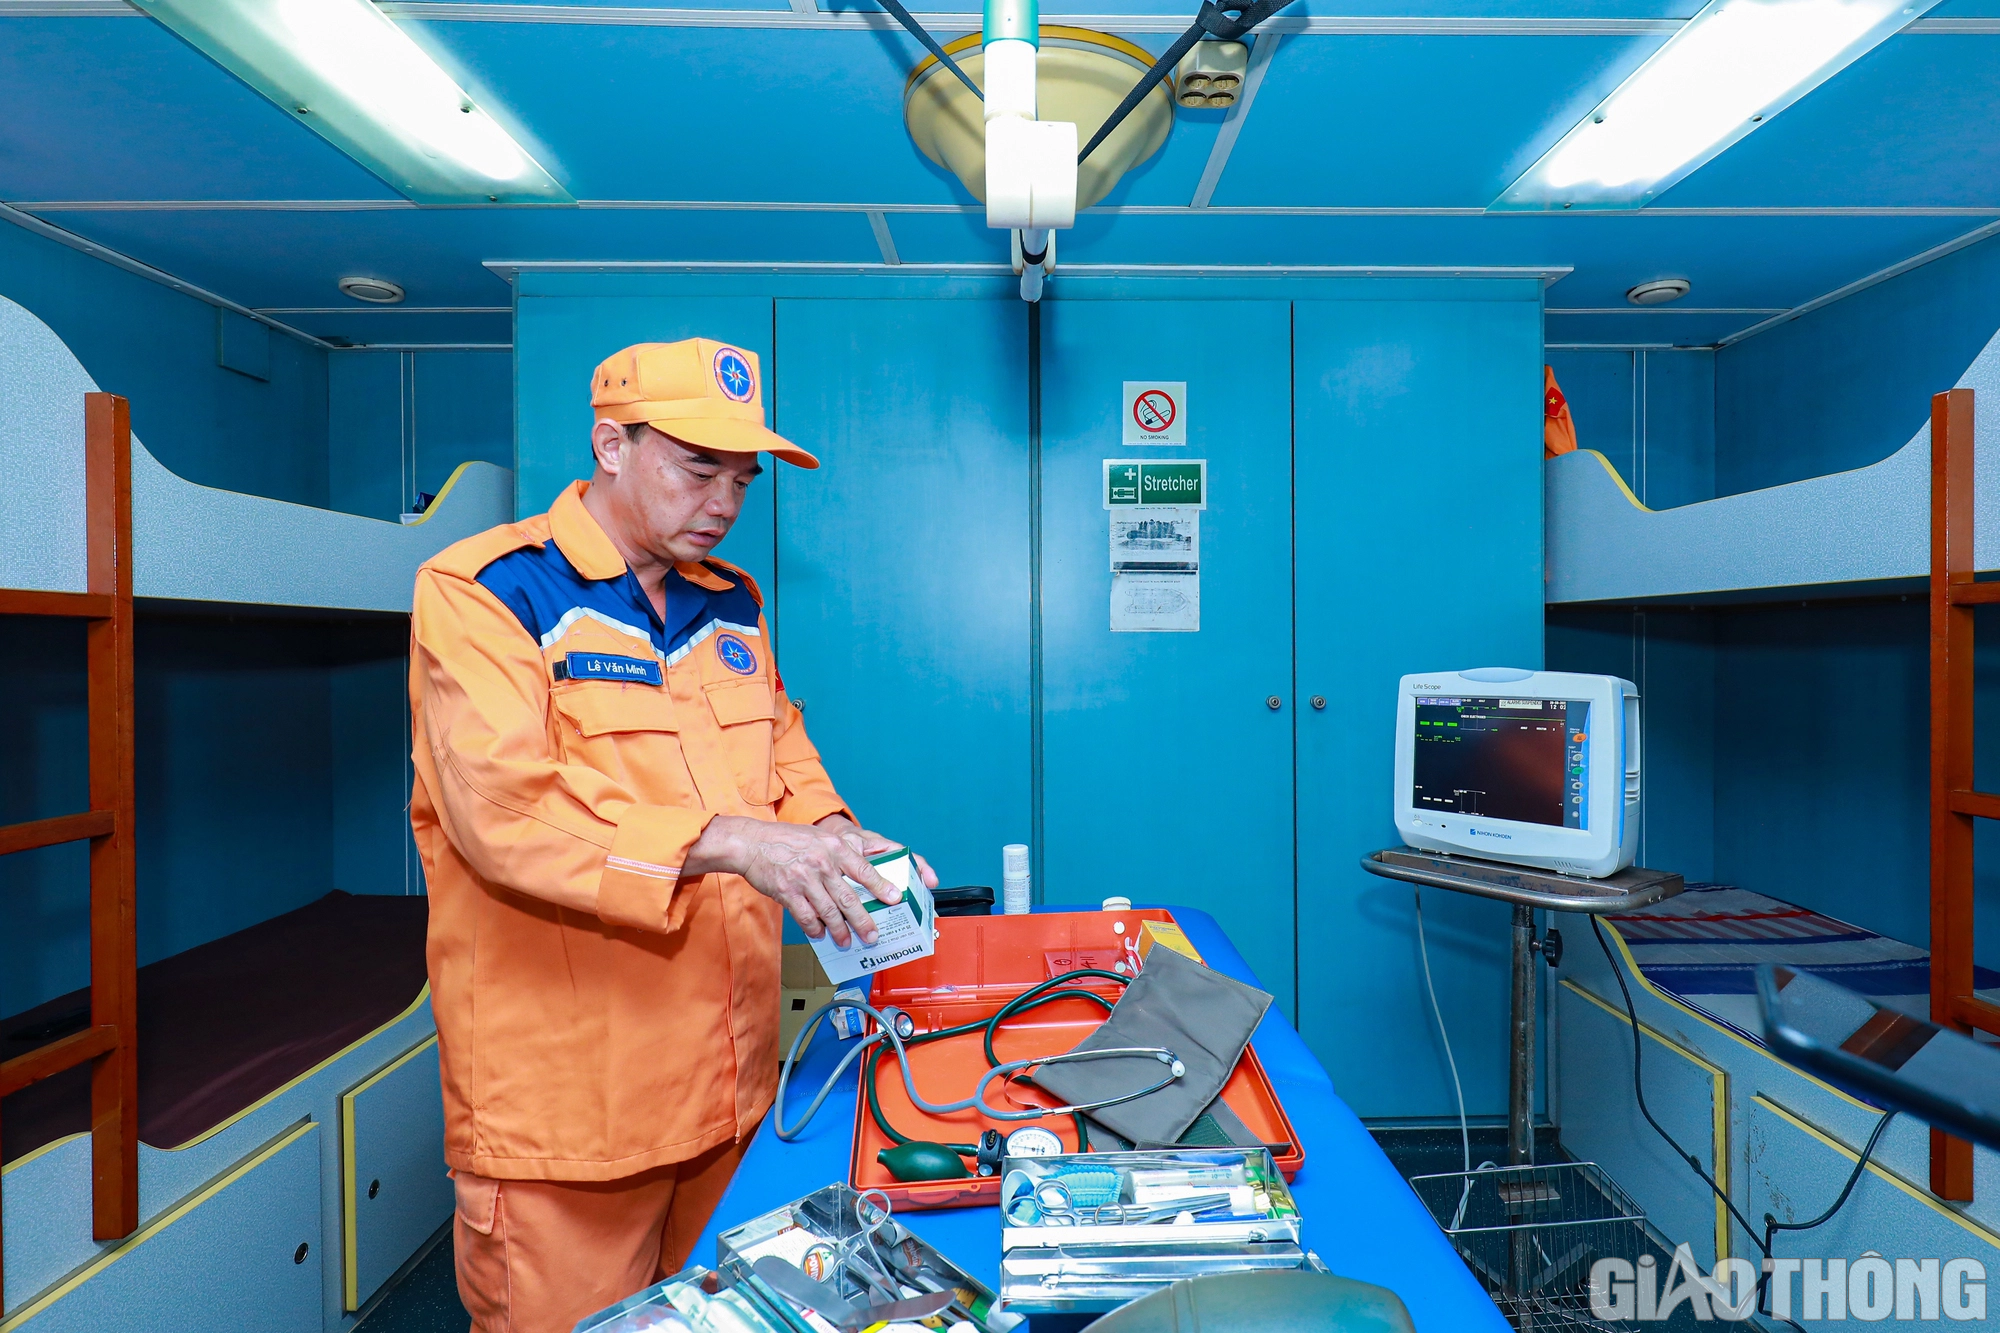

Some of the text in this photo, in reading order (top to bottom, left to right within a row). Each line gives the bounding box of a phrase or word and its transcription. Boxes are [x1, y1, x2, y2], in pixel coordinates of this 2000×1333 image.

[1144, 475, 1198, 491] Stretcher
[587, 659, 647, 676] Lê Văn Minh
[1423, 683, 1441, 691] Scope
[876, 944, 923, 964] Imodium
